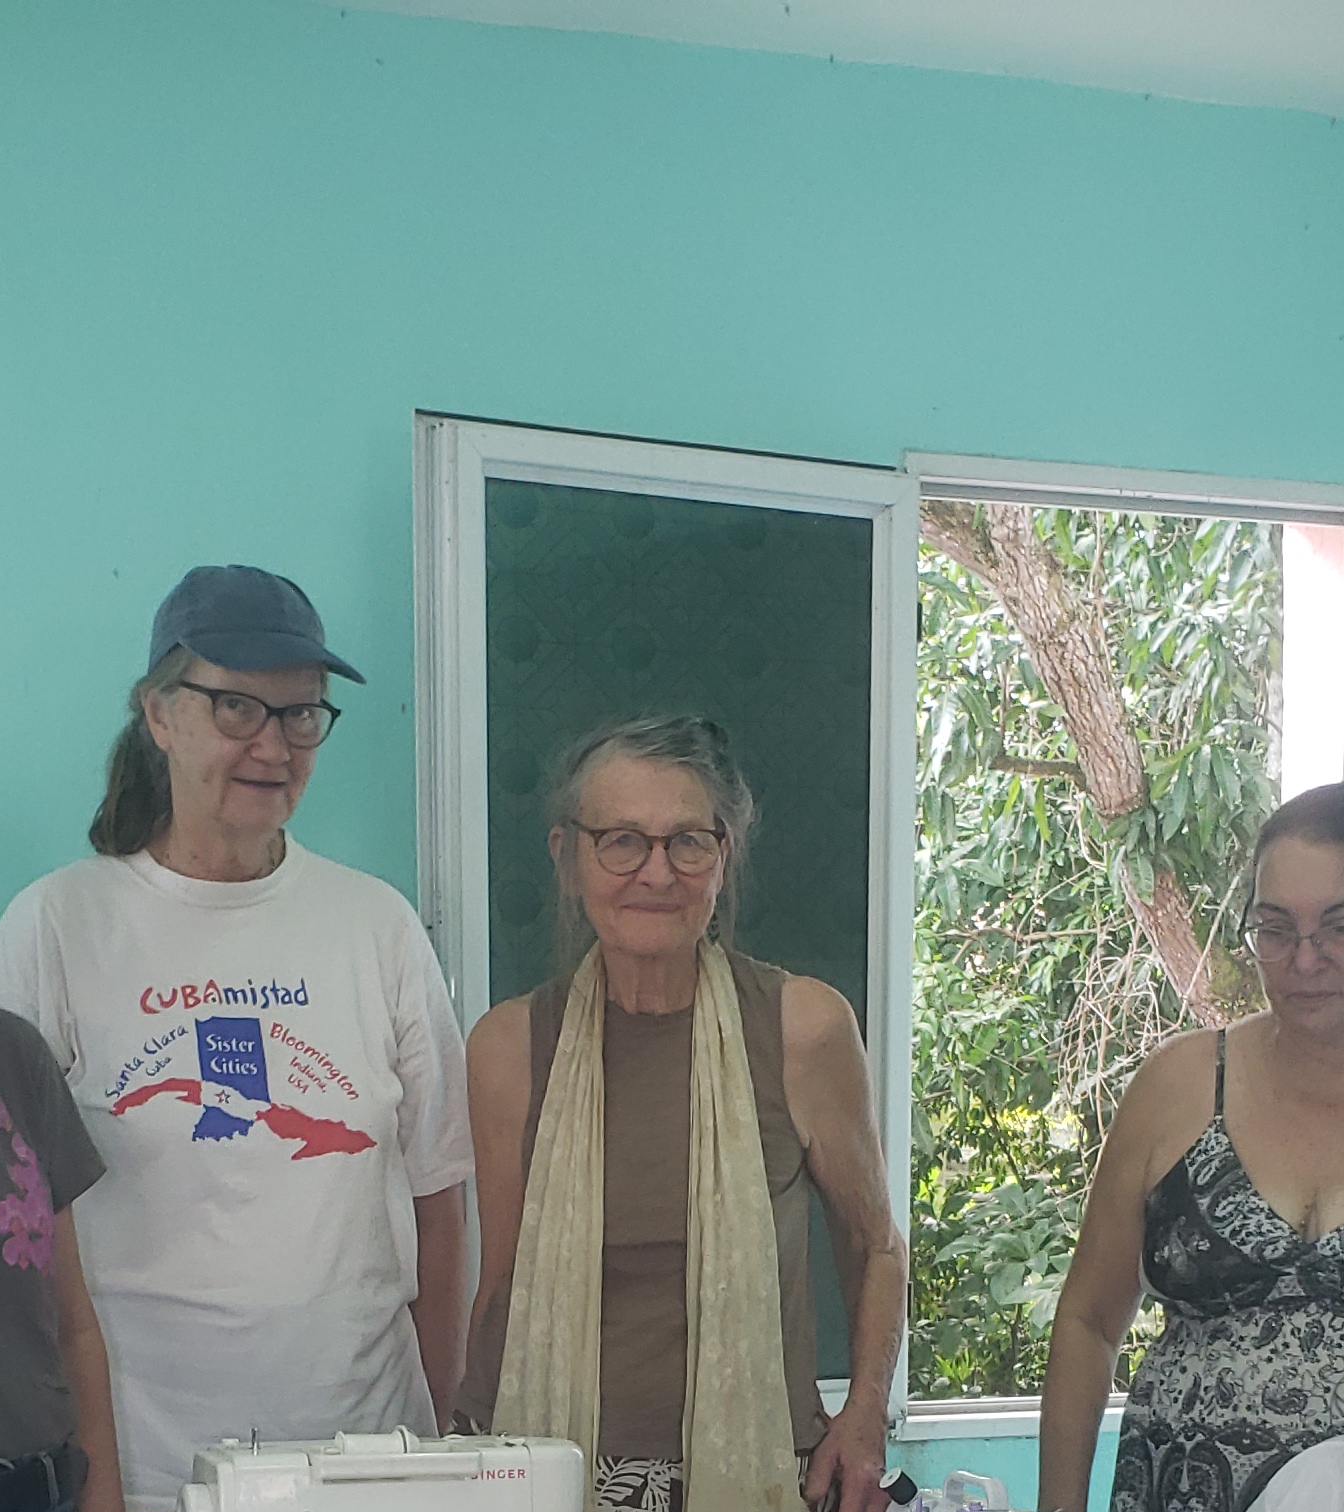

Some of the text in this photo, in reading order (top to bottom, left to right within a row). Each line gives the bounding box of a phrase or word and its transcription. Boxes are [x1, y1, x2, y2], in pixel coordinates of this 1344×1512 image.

[140, 977, 309, 1014] CUBAmistad
[206, 1033, 256, 1053] Sister
[105, 1025, 189, 1098] Santa Clara
[146, 1056, 172, 1076] Cuba
[210, 1057, 258, 1075] Cities
[270, 1022, 359, 1100] Bloomington
[287, 1073, 310, 1094] USA
